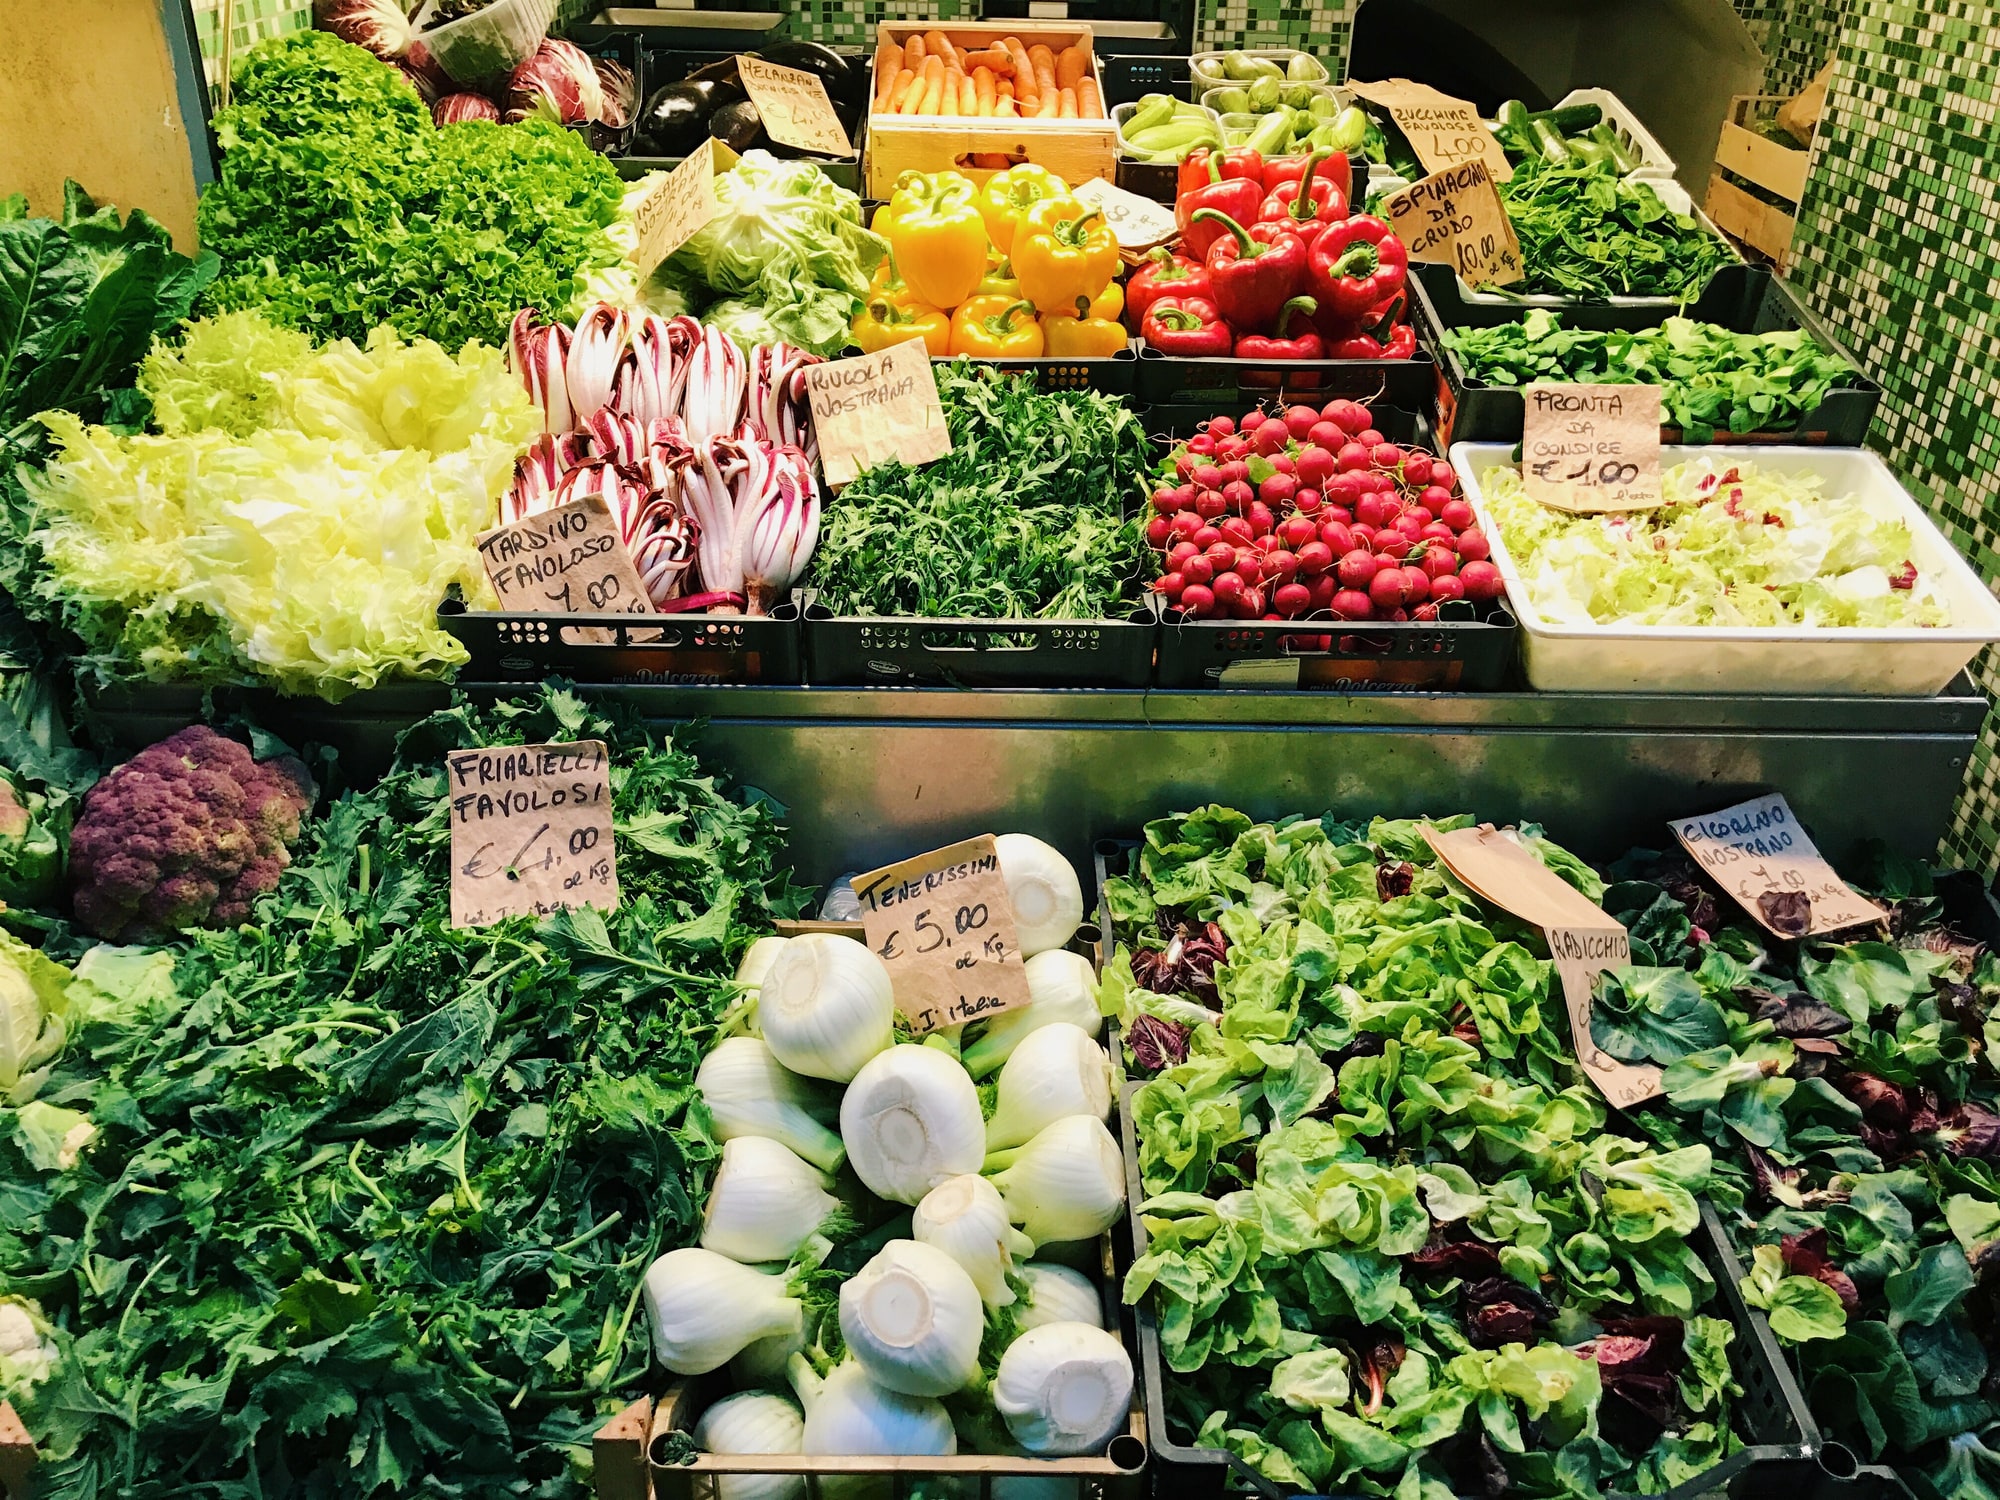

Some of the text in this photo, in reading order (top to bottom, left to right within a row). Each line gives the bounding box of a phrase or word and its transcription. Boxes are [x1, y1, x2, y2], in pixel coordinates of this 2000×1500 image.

[1403, 121, 1479, 133] FAVOLOSE
[1390, 163, 1488, 218] SPINACINO
[1426, 199, 1457, 223] DA
[1411, 215, 1473, 254] CRUDO
[811, 354, 895, 393] RUCOLA
[815, 375, 915, 418] NOSTRANA
[1533, 389, 1623, 416] PRONTA
[1566, 421, 1595, 438] DA
[1532, 441, 1623, 457] CONDIRE
[1531, 459, 1565, 484] €
[478, 511, 588, 564] TARDIVO
[492, 534, 616, 595] FAVOLOSO
[449, 751, 603, 788] FRIARIELLI
[453, 782, 604, 824] FAVOLOSI
[1683, 804, 1786, 844] CICORINO
[460, 841, 502, 879] €
[1700, 830, 1794, 867] NOSTRANO
[589, 857, 611, 886] Kg
[857, 854, 998, 913] TENERISSIMI
[876, 902, 990, 961] € 5,00
[983, 932, 1010, 963] Kg
[1550, 928, 1630, 963] RADICCHIO
